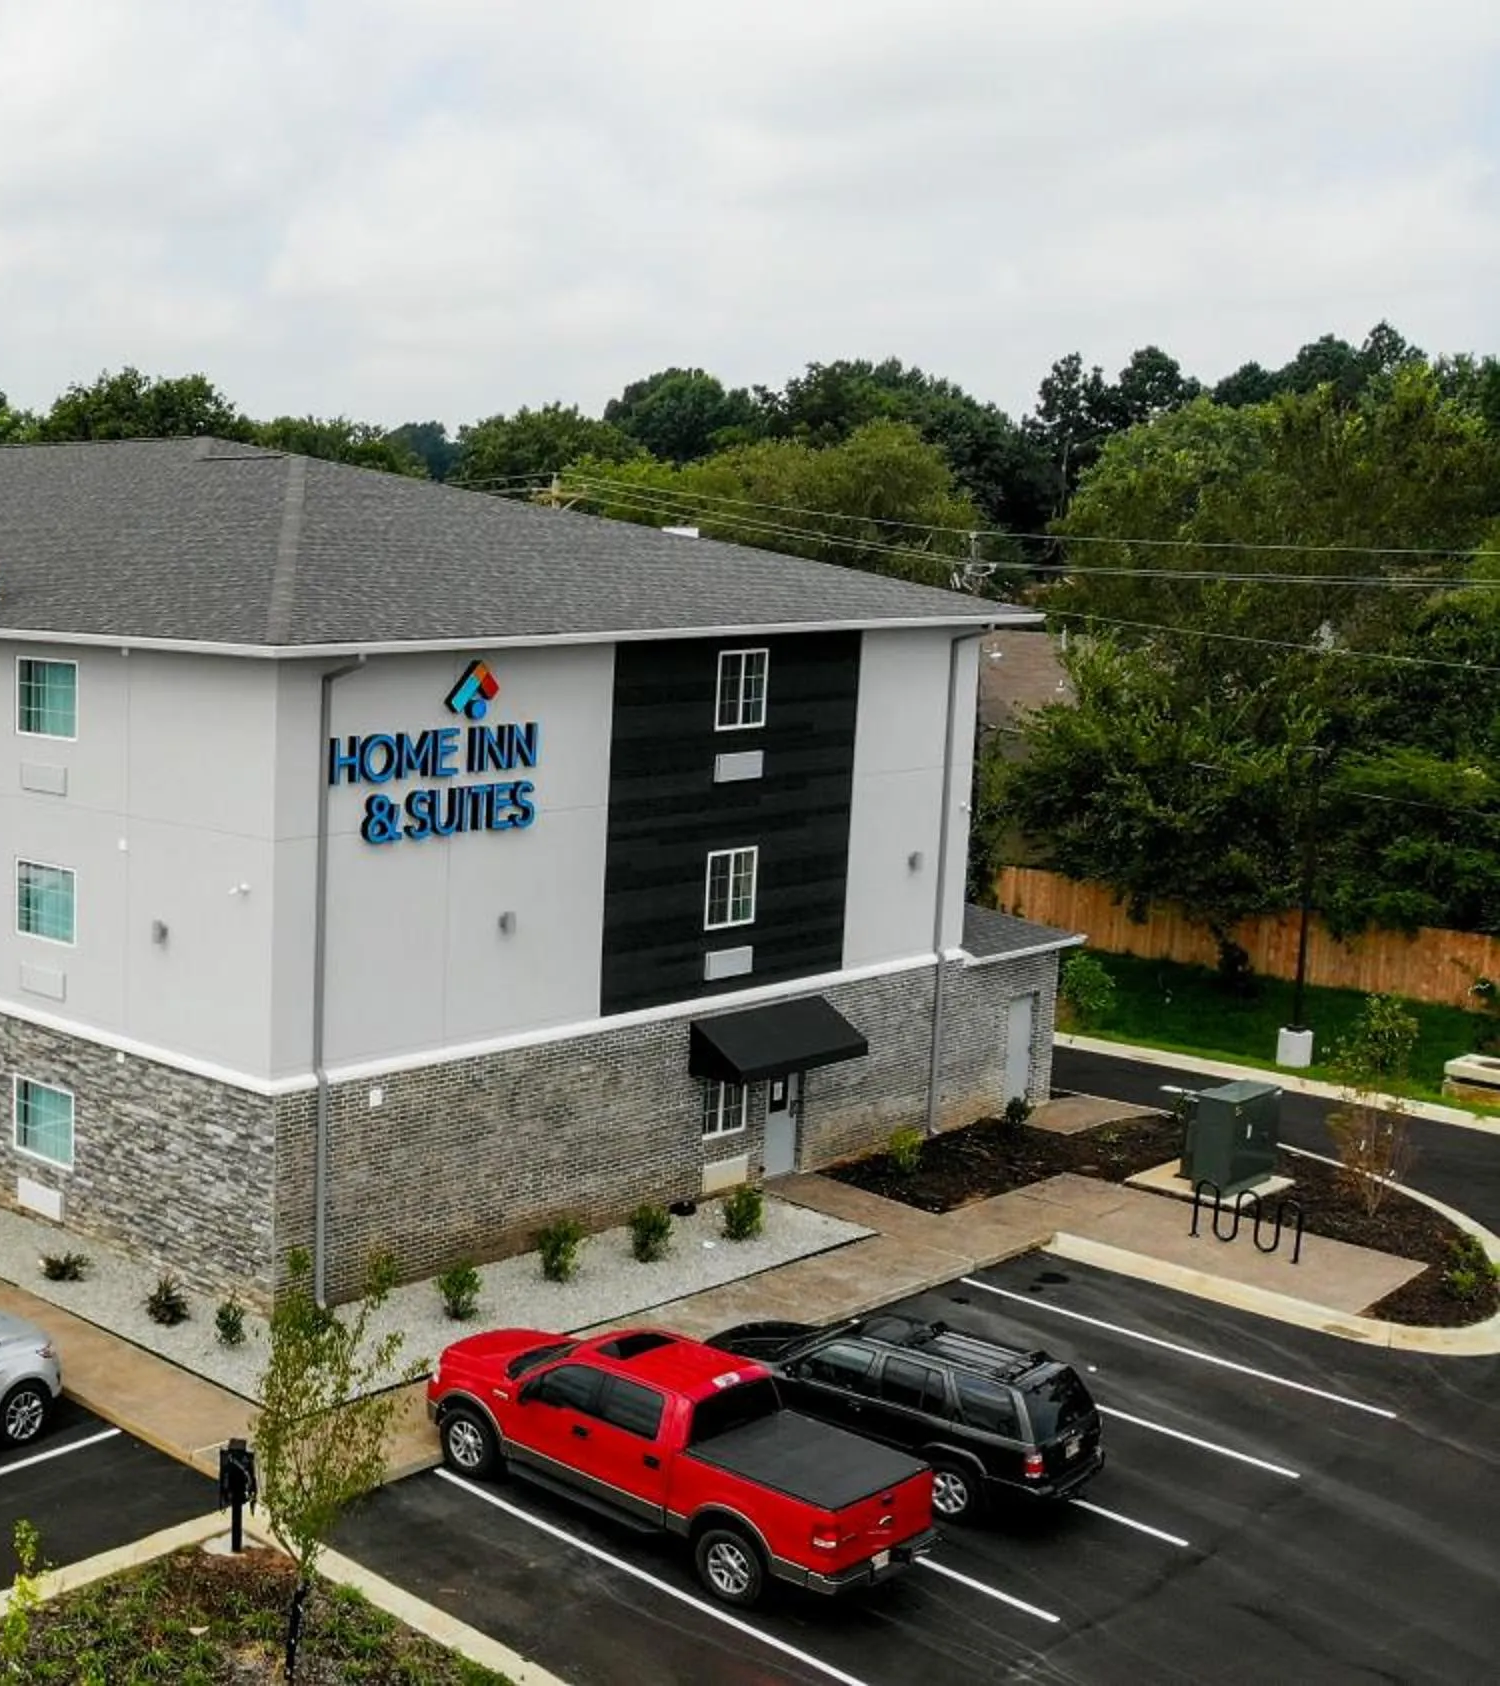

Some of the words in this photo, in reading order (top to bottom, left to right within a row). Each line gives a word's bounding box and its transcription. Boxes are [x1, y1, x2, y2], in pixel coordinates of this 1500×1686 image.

[328, 728, 460, 785] HOME
[466, 722, 538, 773] INN
[361, 793, 402, 844] &
[404, 780, 536, 840] SUITES
